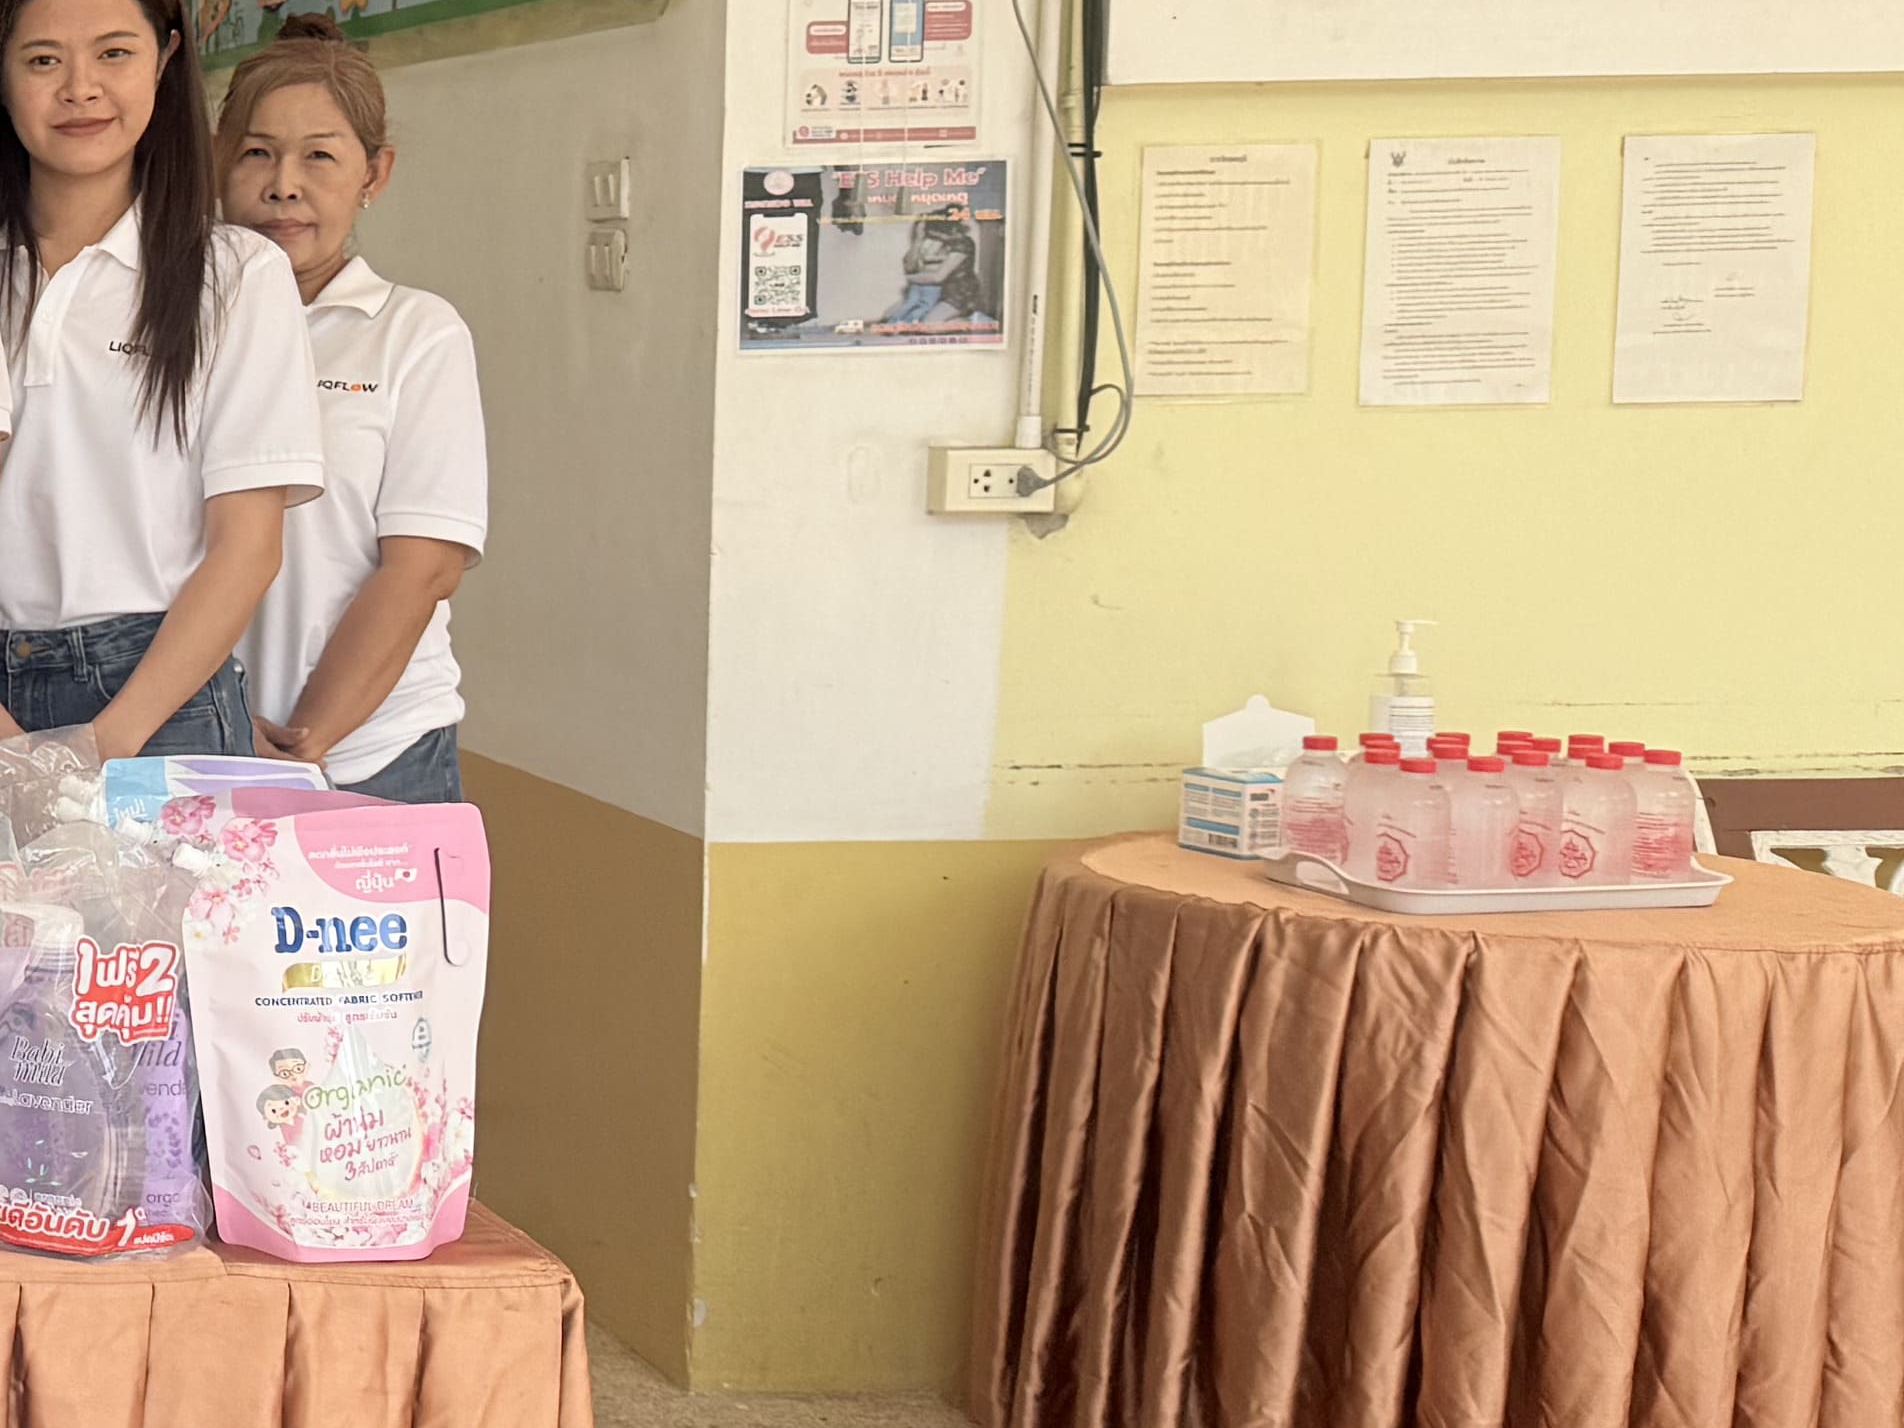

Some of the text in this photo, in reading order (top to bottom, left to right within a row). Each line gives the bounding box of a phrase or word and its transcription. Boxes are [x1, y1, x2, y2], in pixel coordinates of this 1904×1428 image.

[885, 171, 937, 188] Help
[271, 906, 408, 954] D-nee
[10, 1036, 65, 1063] Babi
